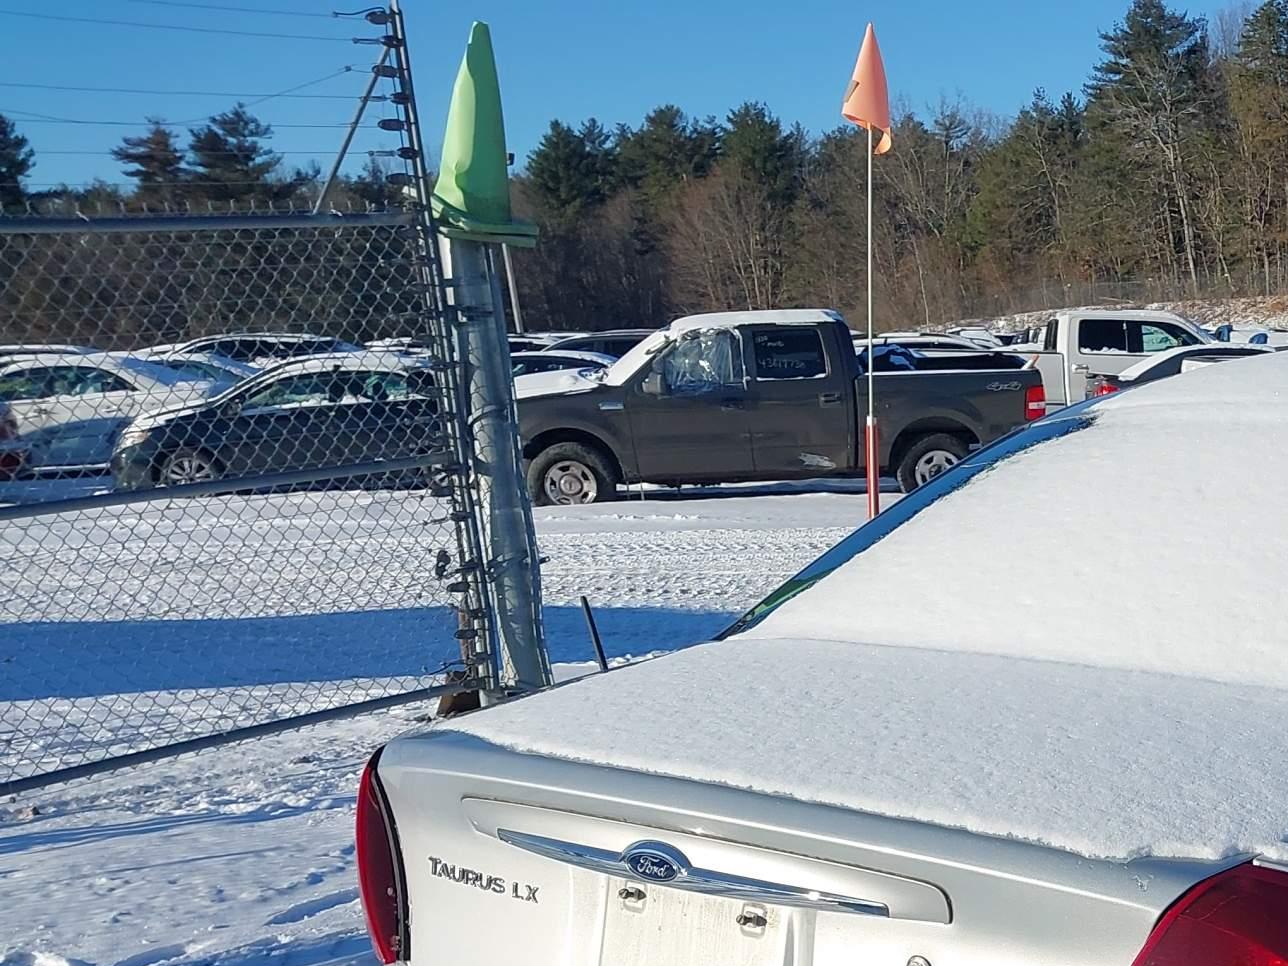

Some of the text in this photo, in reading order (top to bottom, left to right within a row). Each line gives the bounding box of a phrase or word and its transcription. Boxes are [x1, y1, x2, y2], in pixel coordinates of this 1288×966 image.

[428, 856, 540, 904] TAURUS LX
[636, 855, 671, 879] Ford
